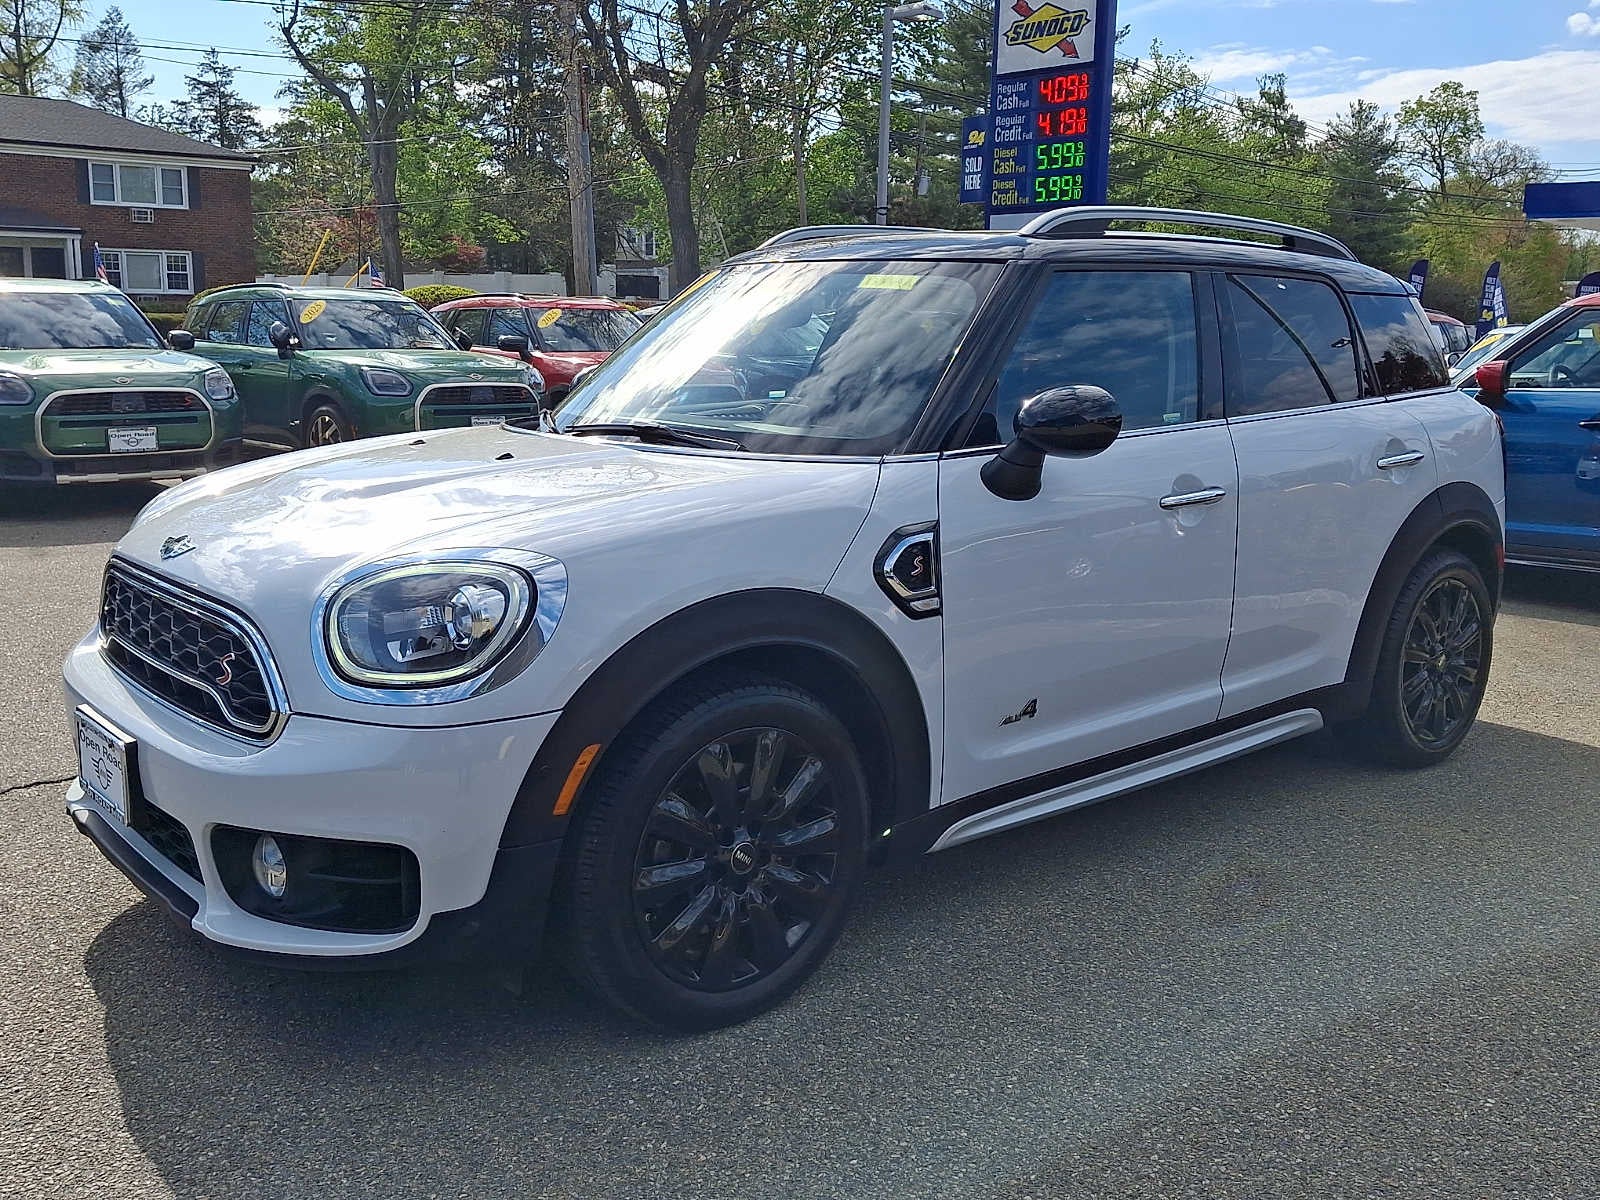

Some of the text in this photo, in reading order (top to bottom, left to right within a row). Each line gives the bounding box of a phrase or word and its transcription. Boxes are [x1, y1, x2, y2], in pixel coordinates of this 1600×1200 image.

[1010, 14, 1084, 42] SUNOCO
[997, 82, 1028, 95] Regular
[1040, 76, 1079, 104] 4.09
[996, 94, 1018, 111] Cash
[995, 115, 1026, 128] Regular
[1038, 108, 1077, 136] 4.19
[995, 125, 1022, 142] Credit
[994, 147, 1018, 158] Diesel
[1037, 142, 1075, 169] 5.99
[965, 156, 983, 173] SOLD
[993, 158, 1015, 174] Cash
[964, 173, 982, 190] HERE
[992, 179, 1016, 190] Diesel
[1035, 175, 1073, 202] 5.99
[991, 190, 1018, 206] Credit
[911, 555, 924, 577] S
[216, 652, 236, 686] S
[79, 729, 101, 753] Open
[735, 850, 753, 865] MINI
